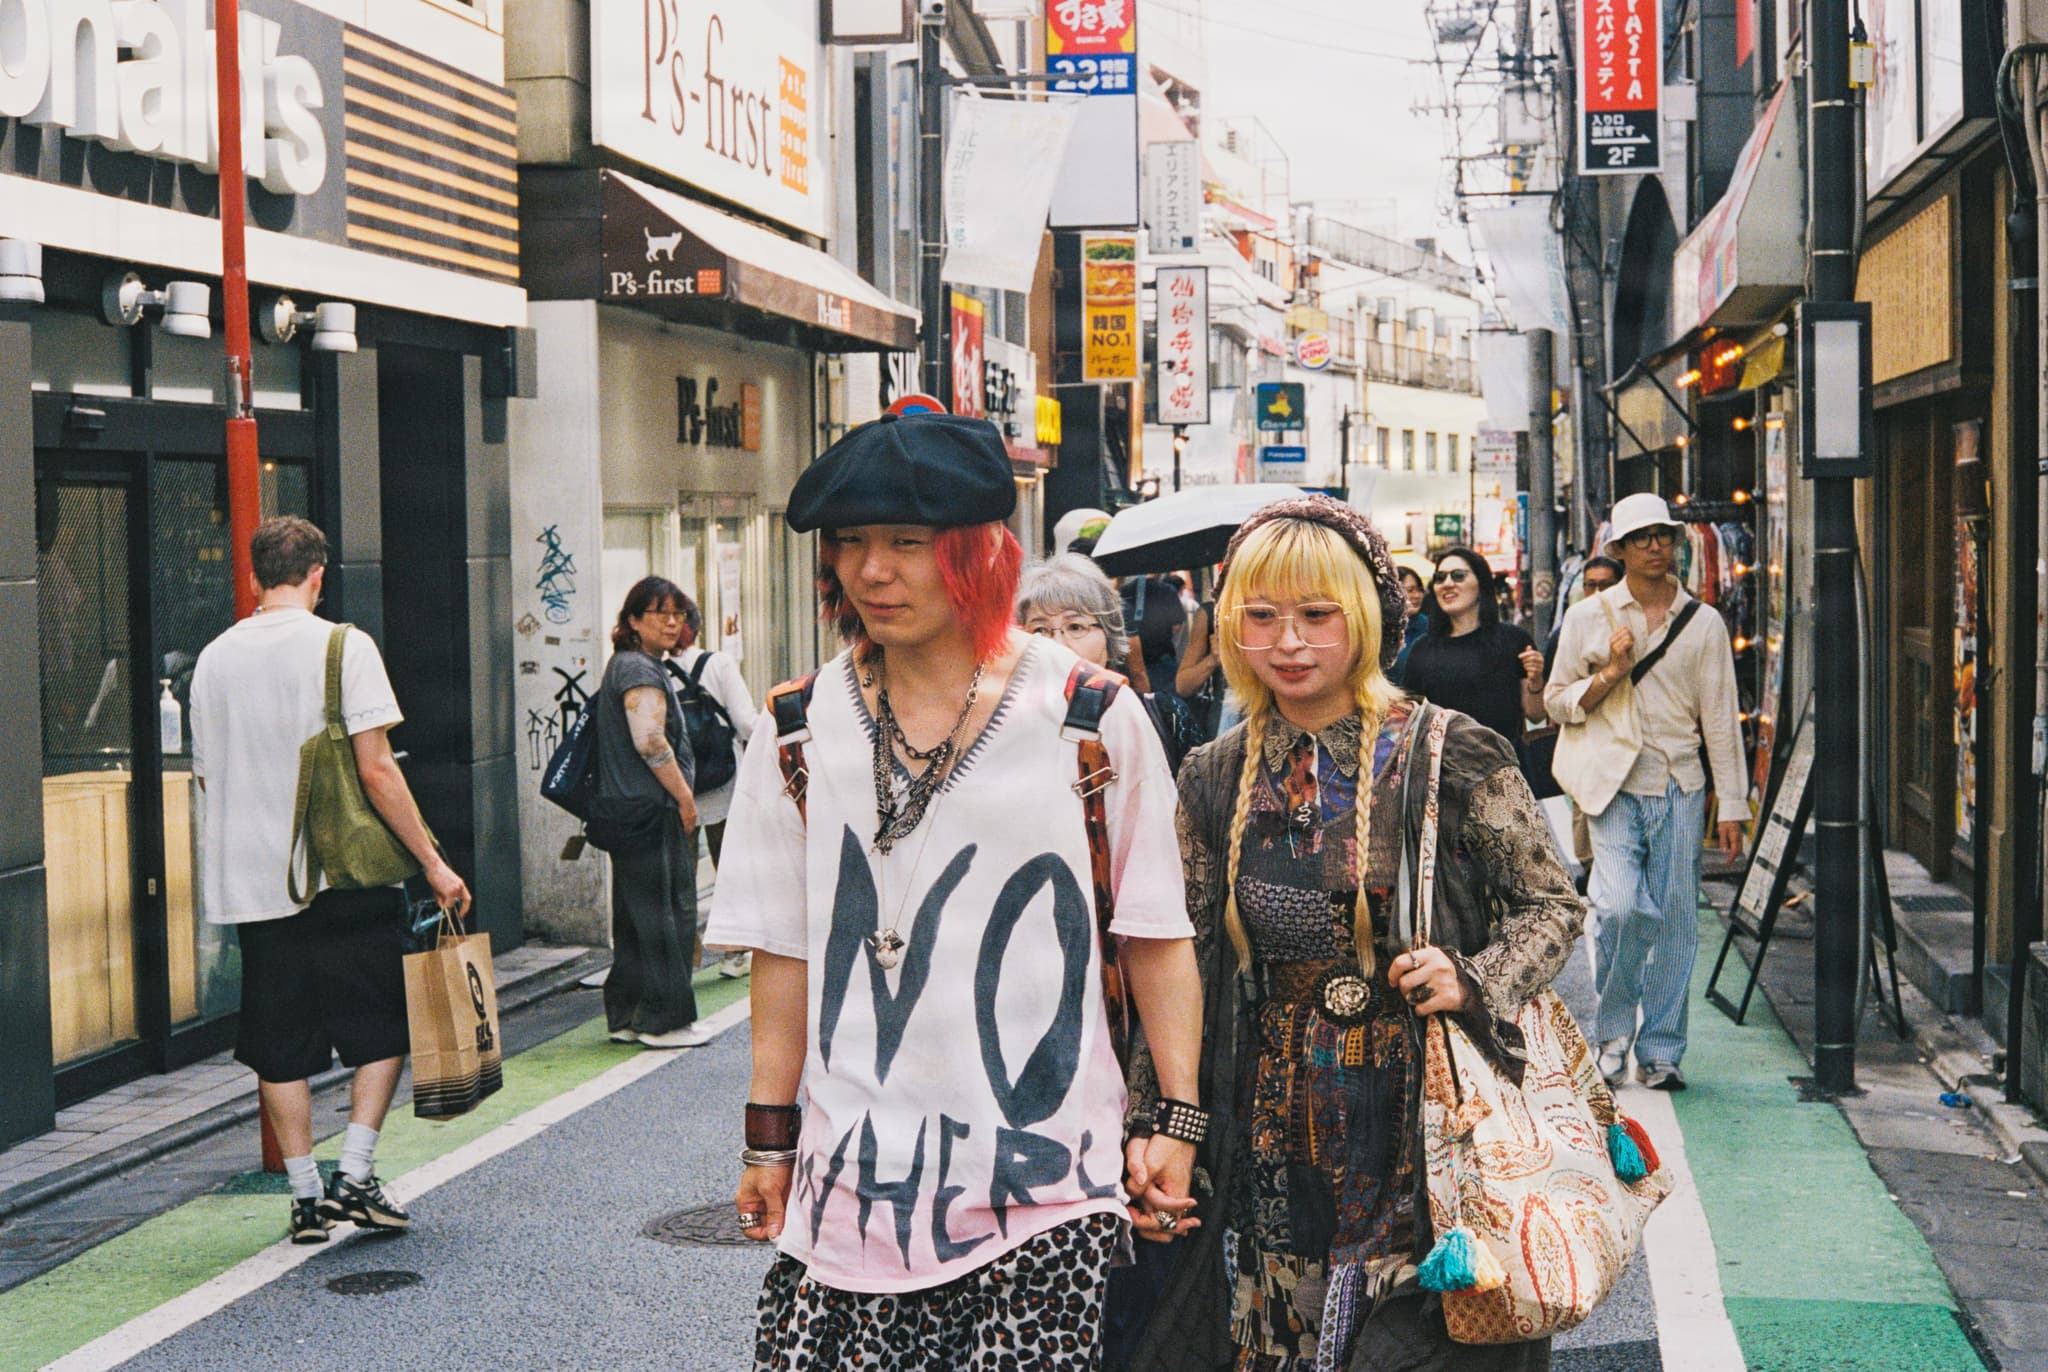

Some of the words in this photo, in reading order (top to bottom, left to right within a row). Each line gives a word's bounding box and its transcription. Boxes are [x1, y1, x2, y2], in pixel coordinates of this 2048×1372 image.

[1055, 0, 1126, 34] すき家
[641, 0, 772, 177] P's-first
[1055, 59, 1099, 90] 23
[1591, 114, 1625, 126] 入り口
[1607, 146, 1636, 166] 2F
[1167, 144, 1179, 248] エリアクエスト
[610, 269, 695, 296] P's-first
[1093, 315, 1126, 331] 韓国
[1092, 333, 1130, 347] NO.1
[818, 822, 1093, 1129] NO
